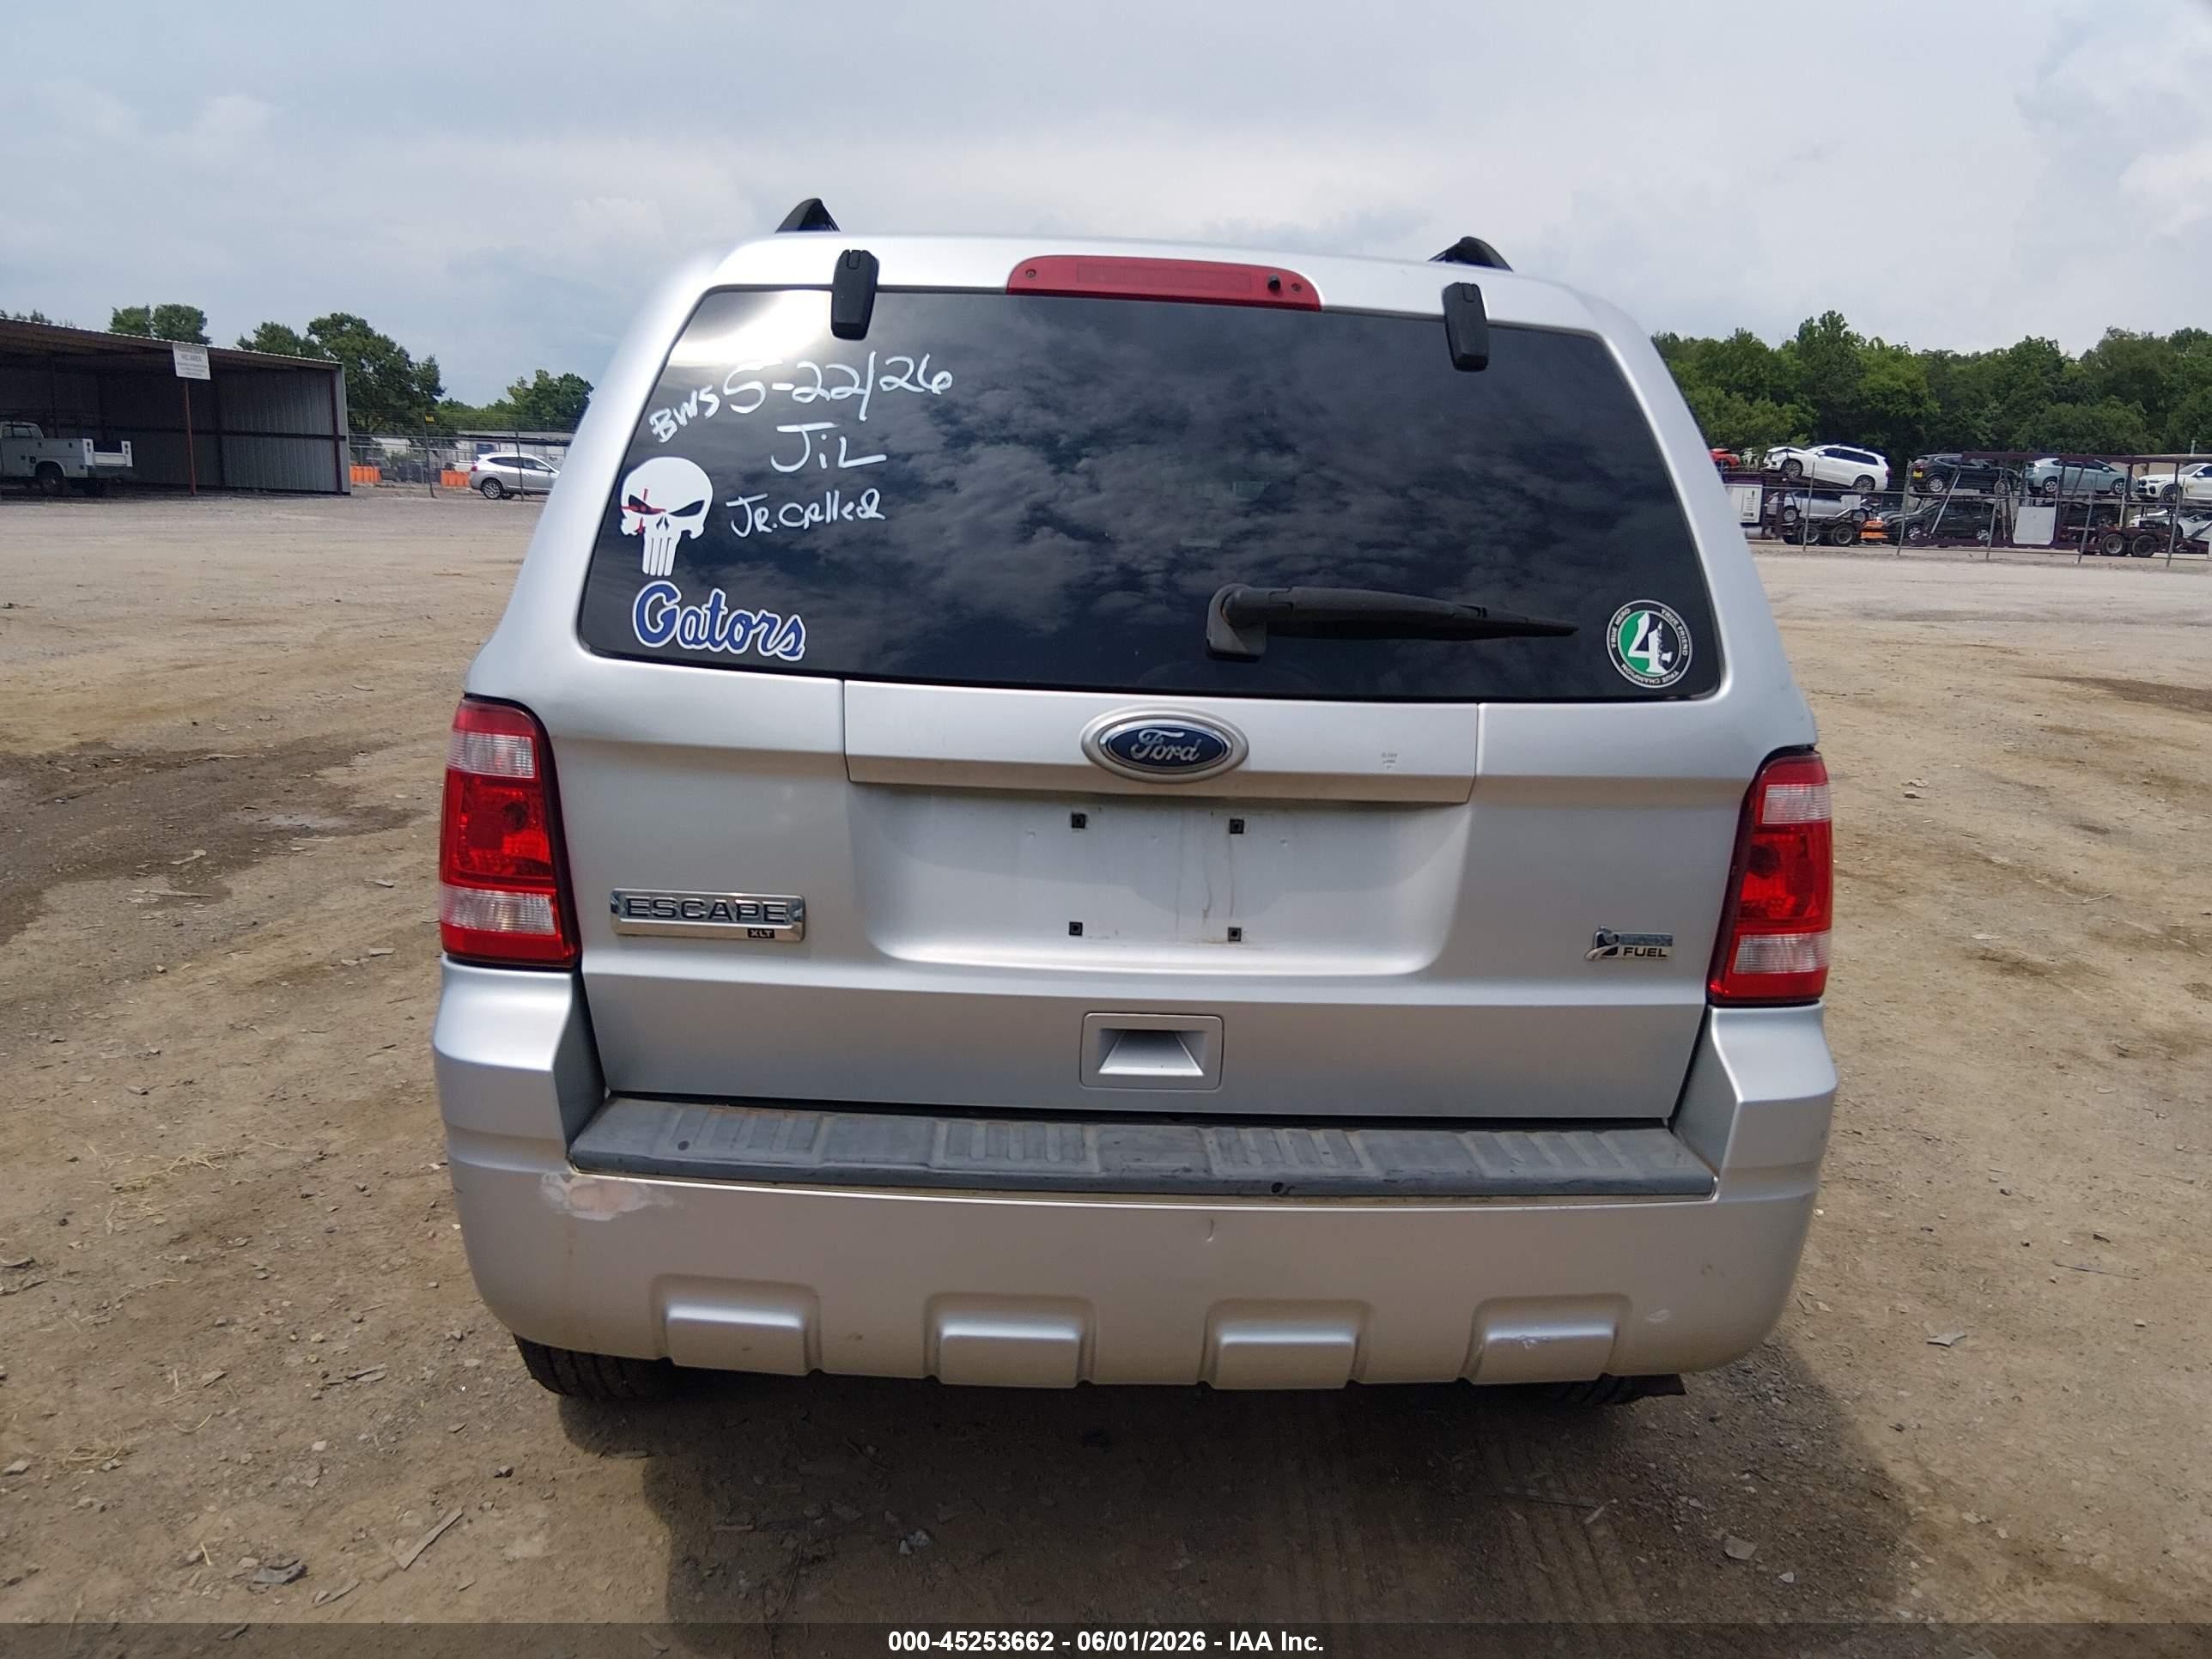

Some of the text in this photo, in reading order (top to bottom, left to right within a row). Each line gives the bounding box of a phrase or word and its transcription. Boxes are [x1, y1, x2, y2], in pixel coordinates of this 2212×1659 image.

[632, 580, 806, 661] Gators
[1677, 625, 1689, 657] FRIEND
[1130, 728, 1201, 762] Ford
[625, 896, 789, 922] ESCAPE
[749, 929, 773, 938] XLT
[1623, 946, 1668, 957] FUEL
